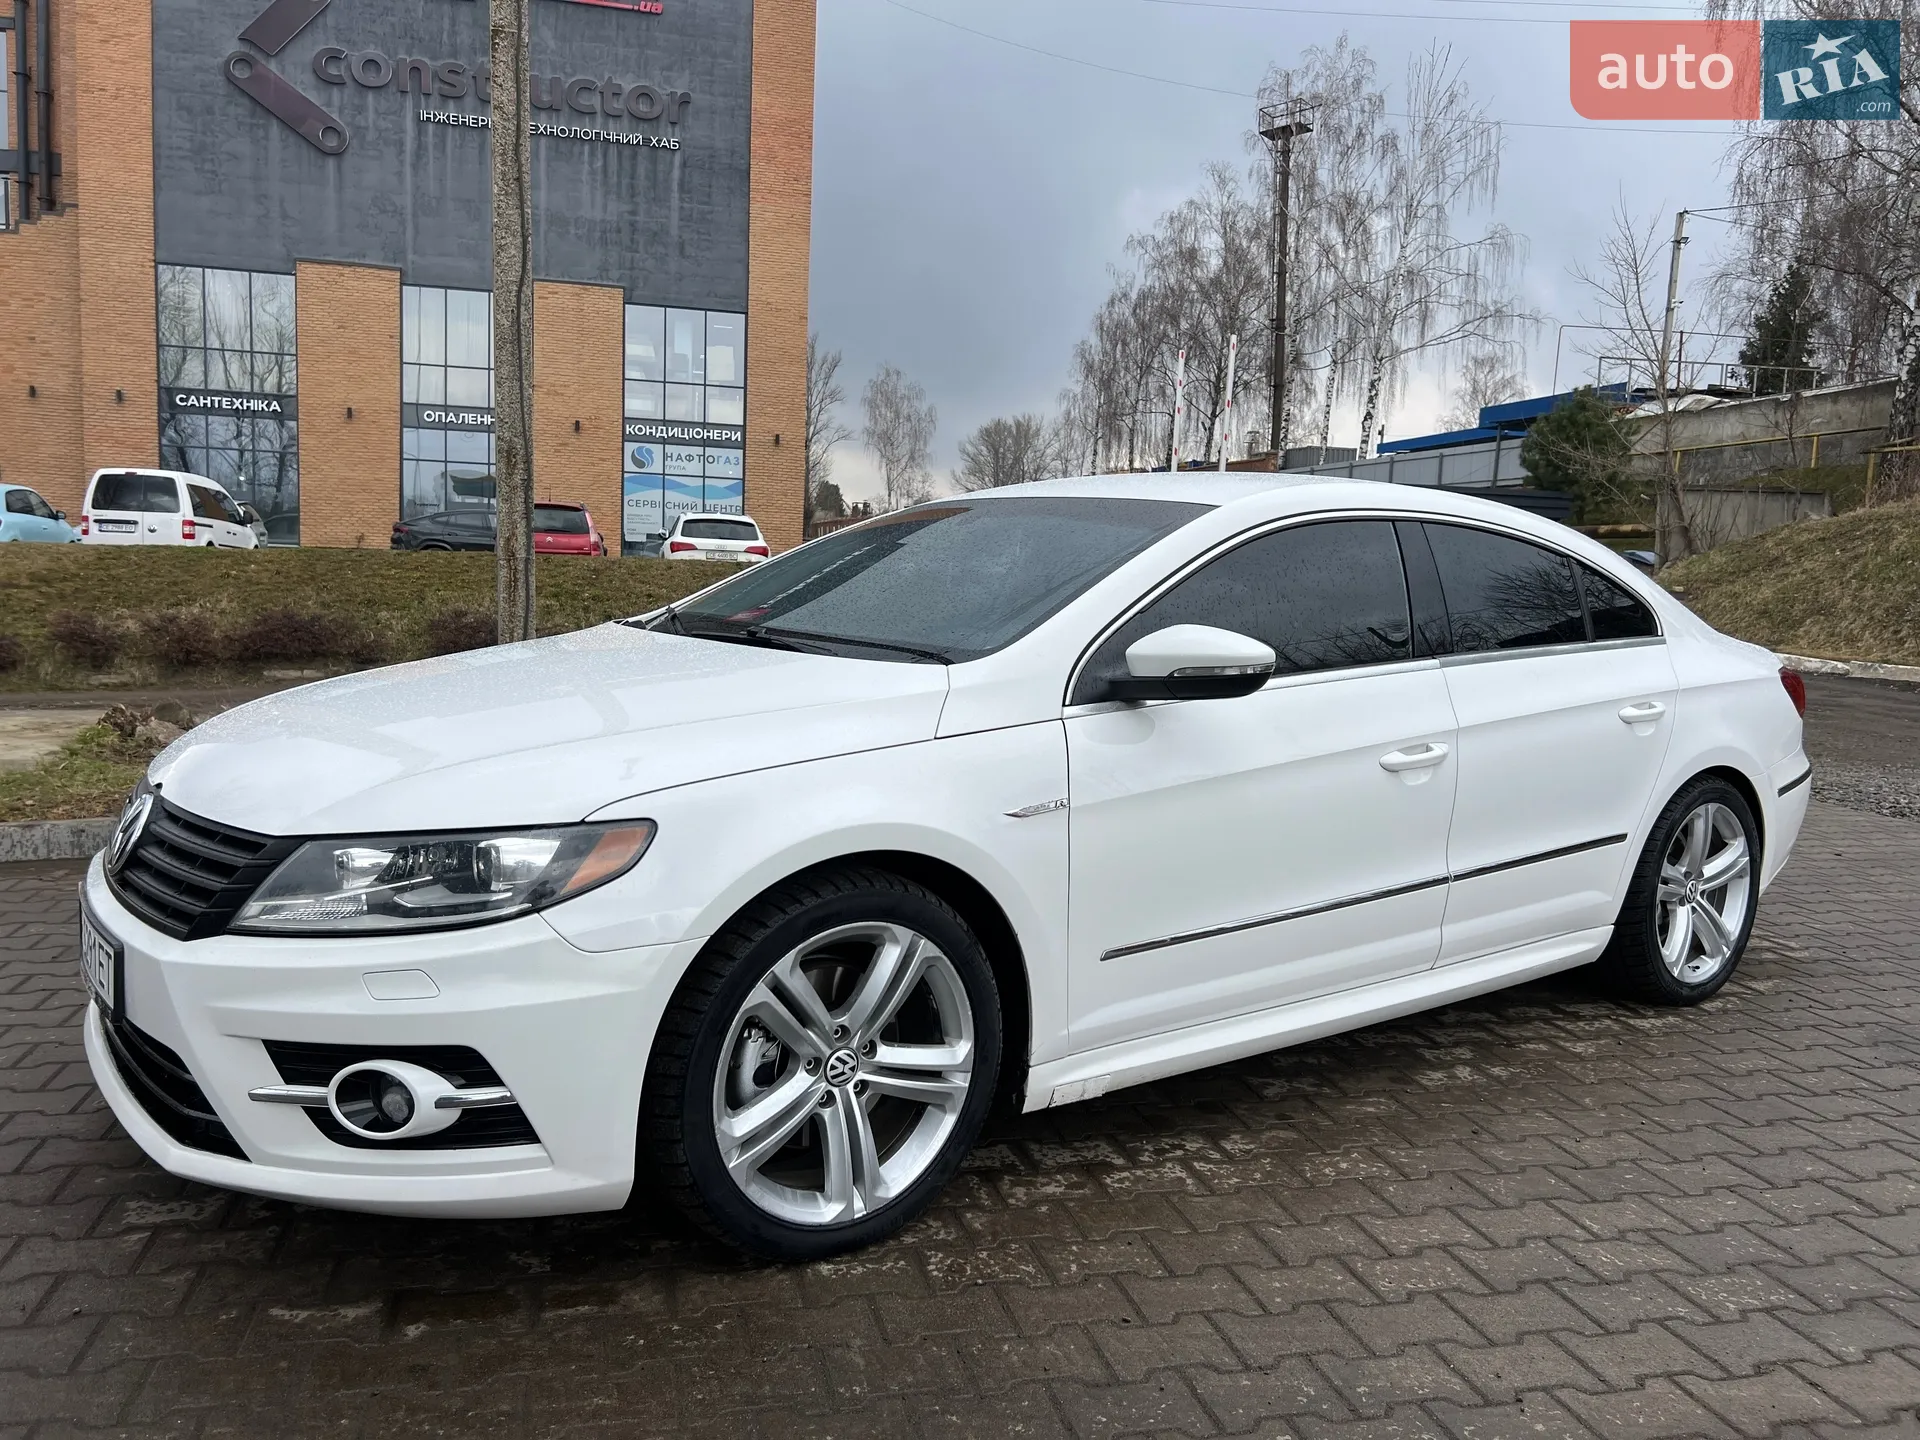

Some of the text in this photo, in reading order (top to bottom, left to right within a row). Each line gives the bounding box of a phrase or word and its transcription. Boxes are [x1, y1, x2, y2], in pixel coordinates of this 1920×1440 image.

[312, 46, 692, 124] constuctor
[650, 135, 679, 150] ХАБ
[175, 394, 282, 413] САНТЕХНІКА
[423, 410, 496, 426] ОПАЛЕНН
[626, 424, 741, 442] КОНДИЦІОНЕРИ
[665, 452, 740, 466] НАФТОГАЗ
[705, 503, 742, 514] ЦЕНТР
